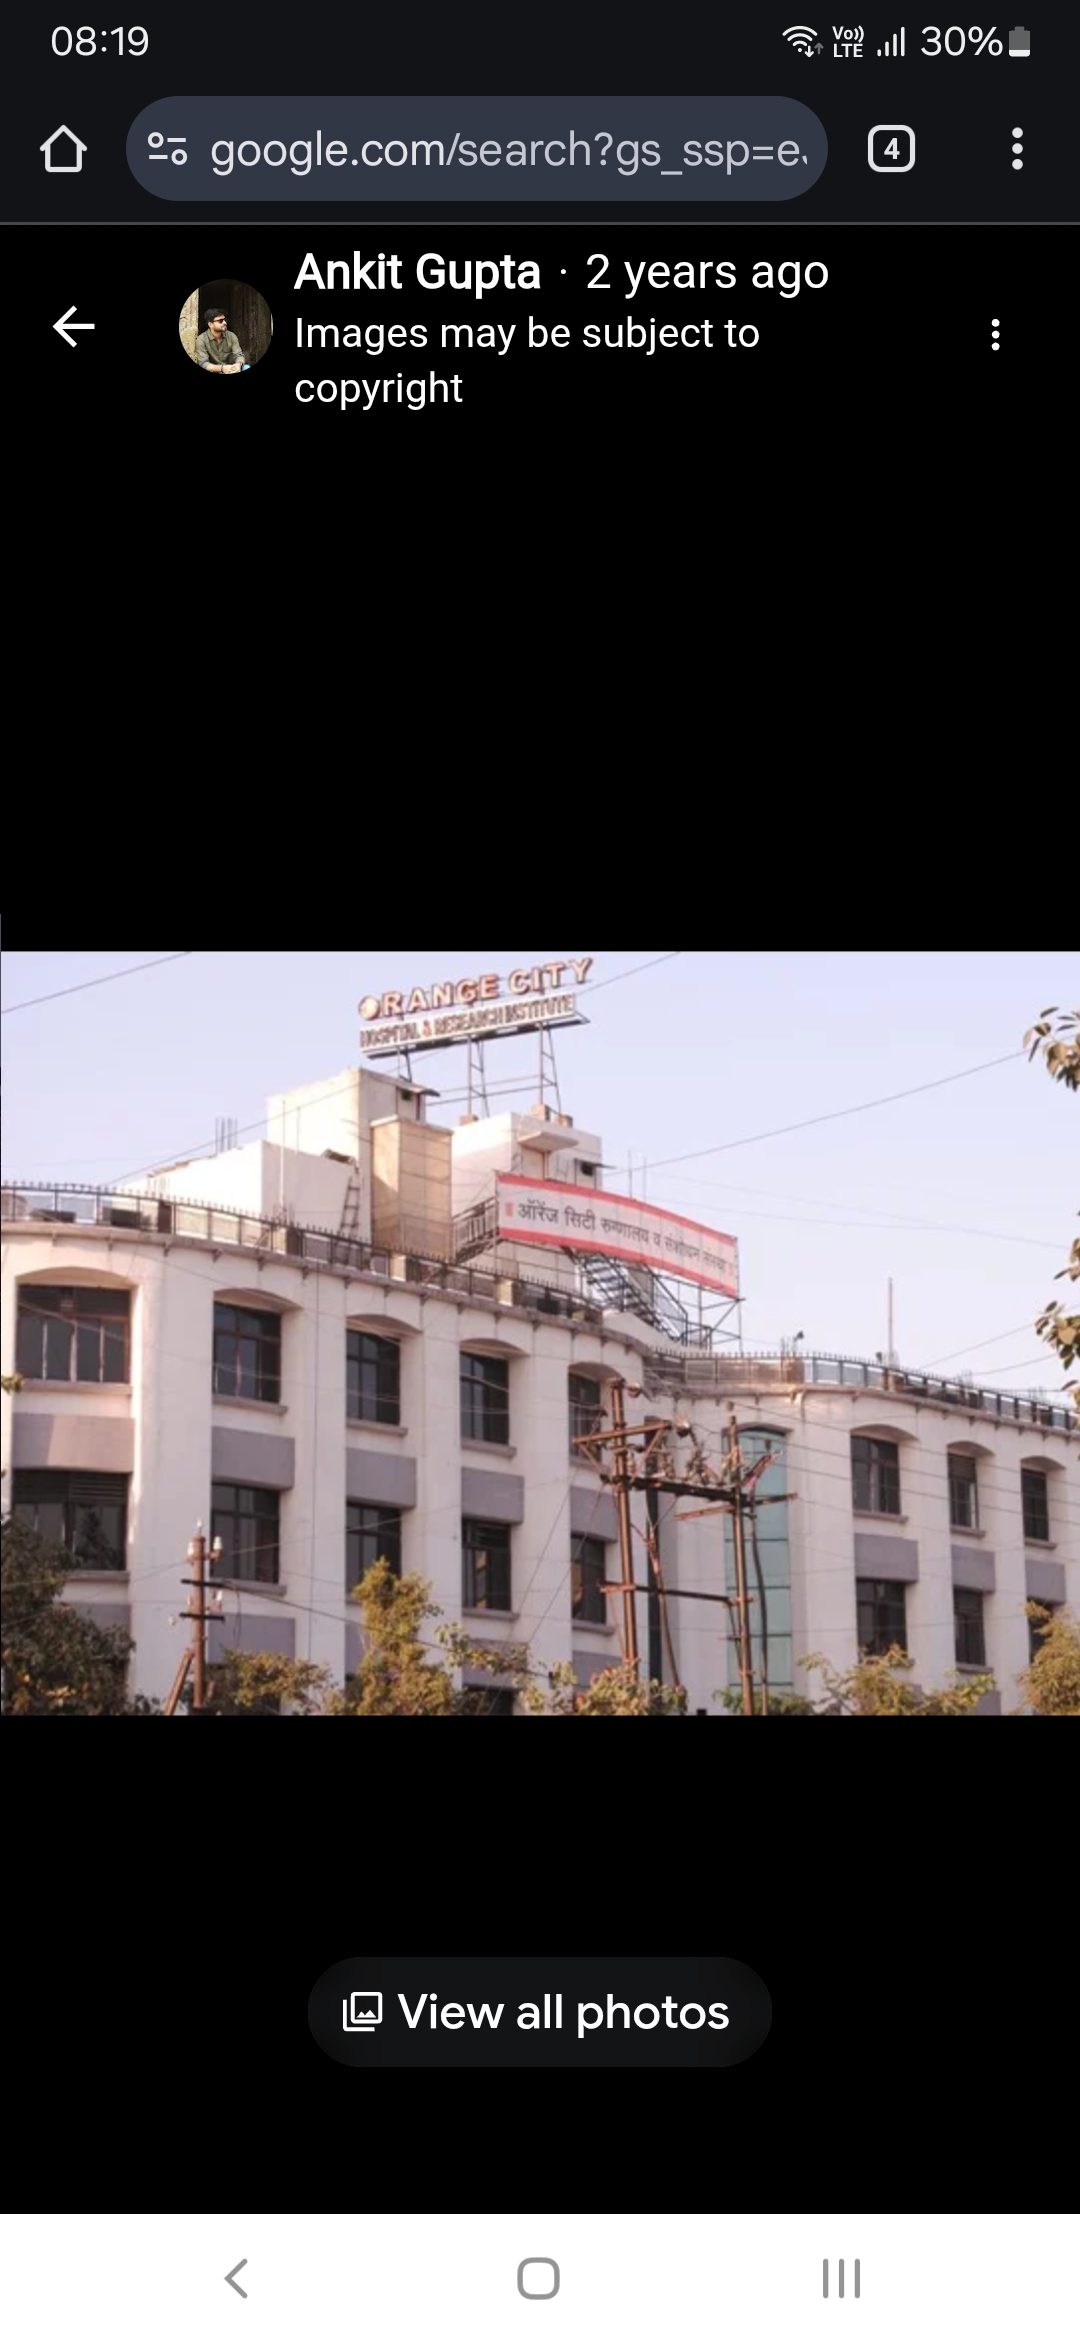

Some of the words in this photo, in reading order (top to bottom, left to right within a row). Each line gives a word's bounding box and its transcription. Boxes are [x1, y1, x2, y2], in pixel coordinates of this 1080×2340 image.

[358, 973, 499, 1021] ORANGE
[509, 957, 593, 994] CITY
[518, 1199, 558, 1224] ऑरेंज
[564, 1205, 595, 1231] सिटी
